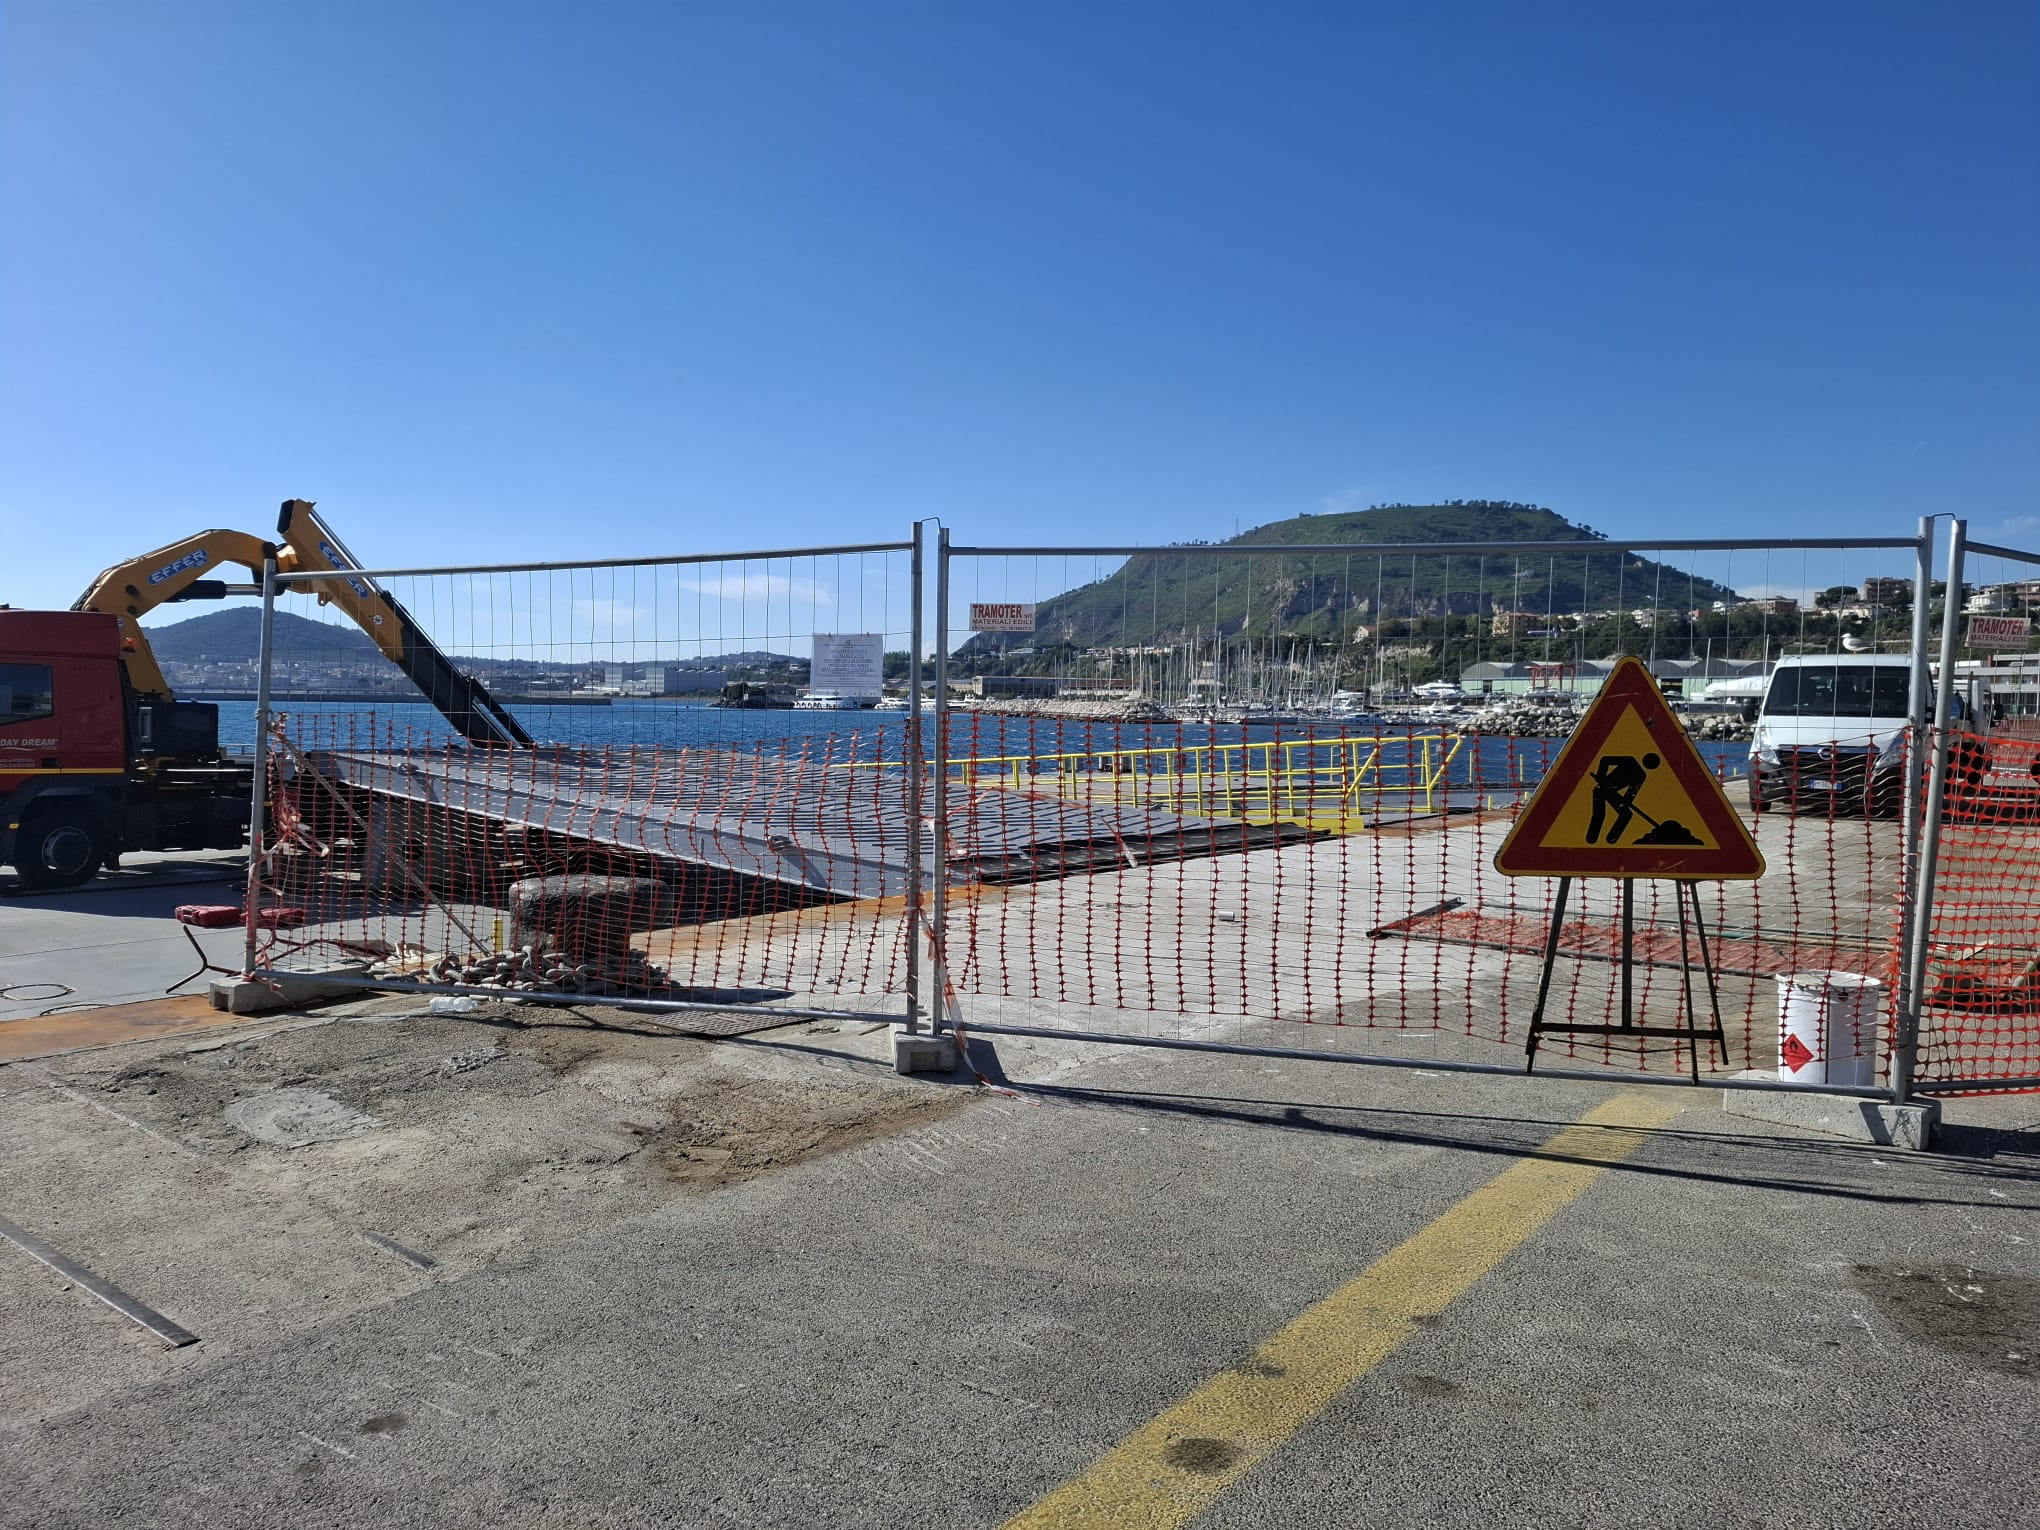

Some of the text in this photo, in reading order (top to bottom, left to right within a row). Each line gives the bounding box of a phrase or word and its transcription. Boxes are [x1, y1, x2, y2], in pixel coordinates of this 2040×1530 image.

[151, 550, 205, 582] EFFER
[972, 604, 1022, 618] TRAMOTER
[1972, 617, 2024, 636] TRAMOTER
[21, 738, 56, 746] DREAM
